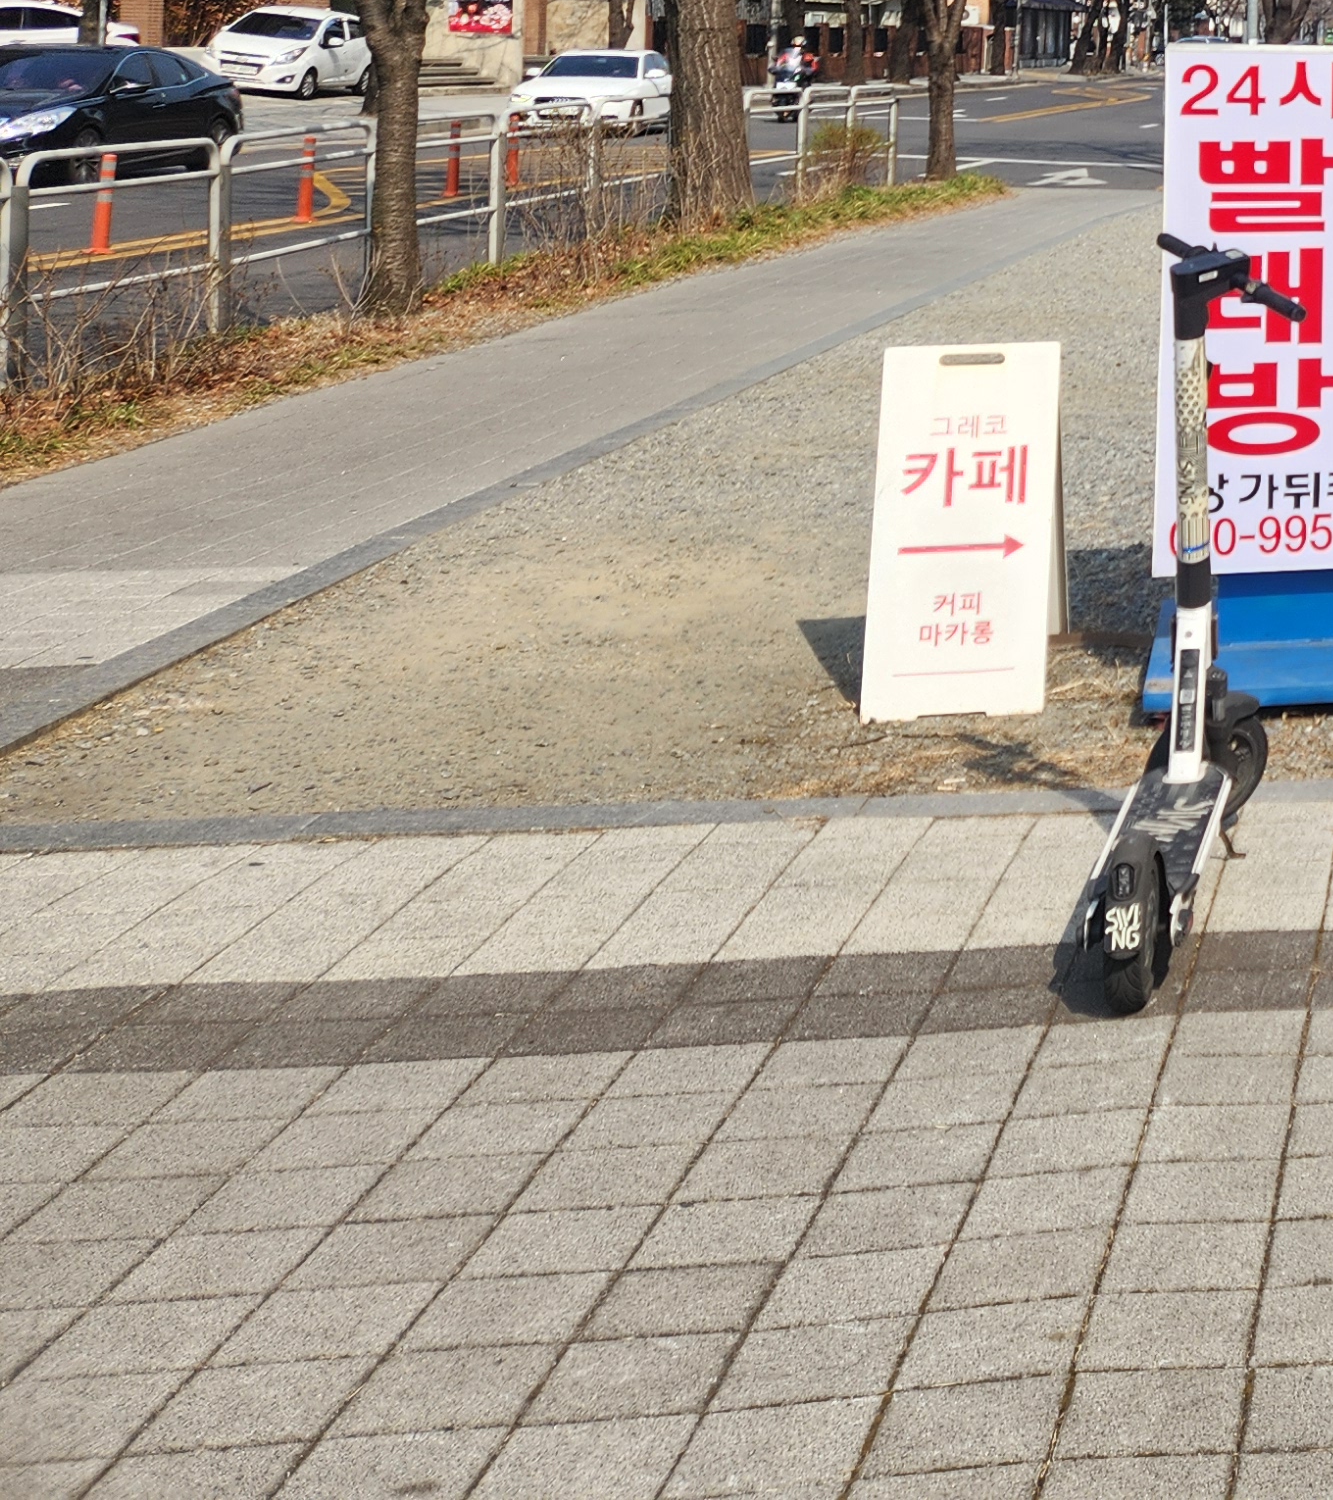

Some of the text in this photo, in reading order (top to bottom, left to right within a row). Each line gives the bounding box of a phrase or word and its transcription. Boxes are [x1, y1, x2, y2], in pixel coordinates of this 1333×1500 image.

[930, 414, 1008, 438] 그레코
[900, 444, 1029, 508] 카페
[932, 591, 983, 617] 커피
[919, 620, 994, 647] 마카롱
